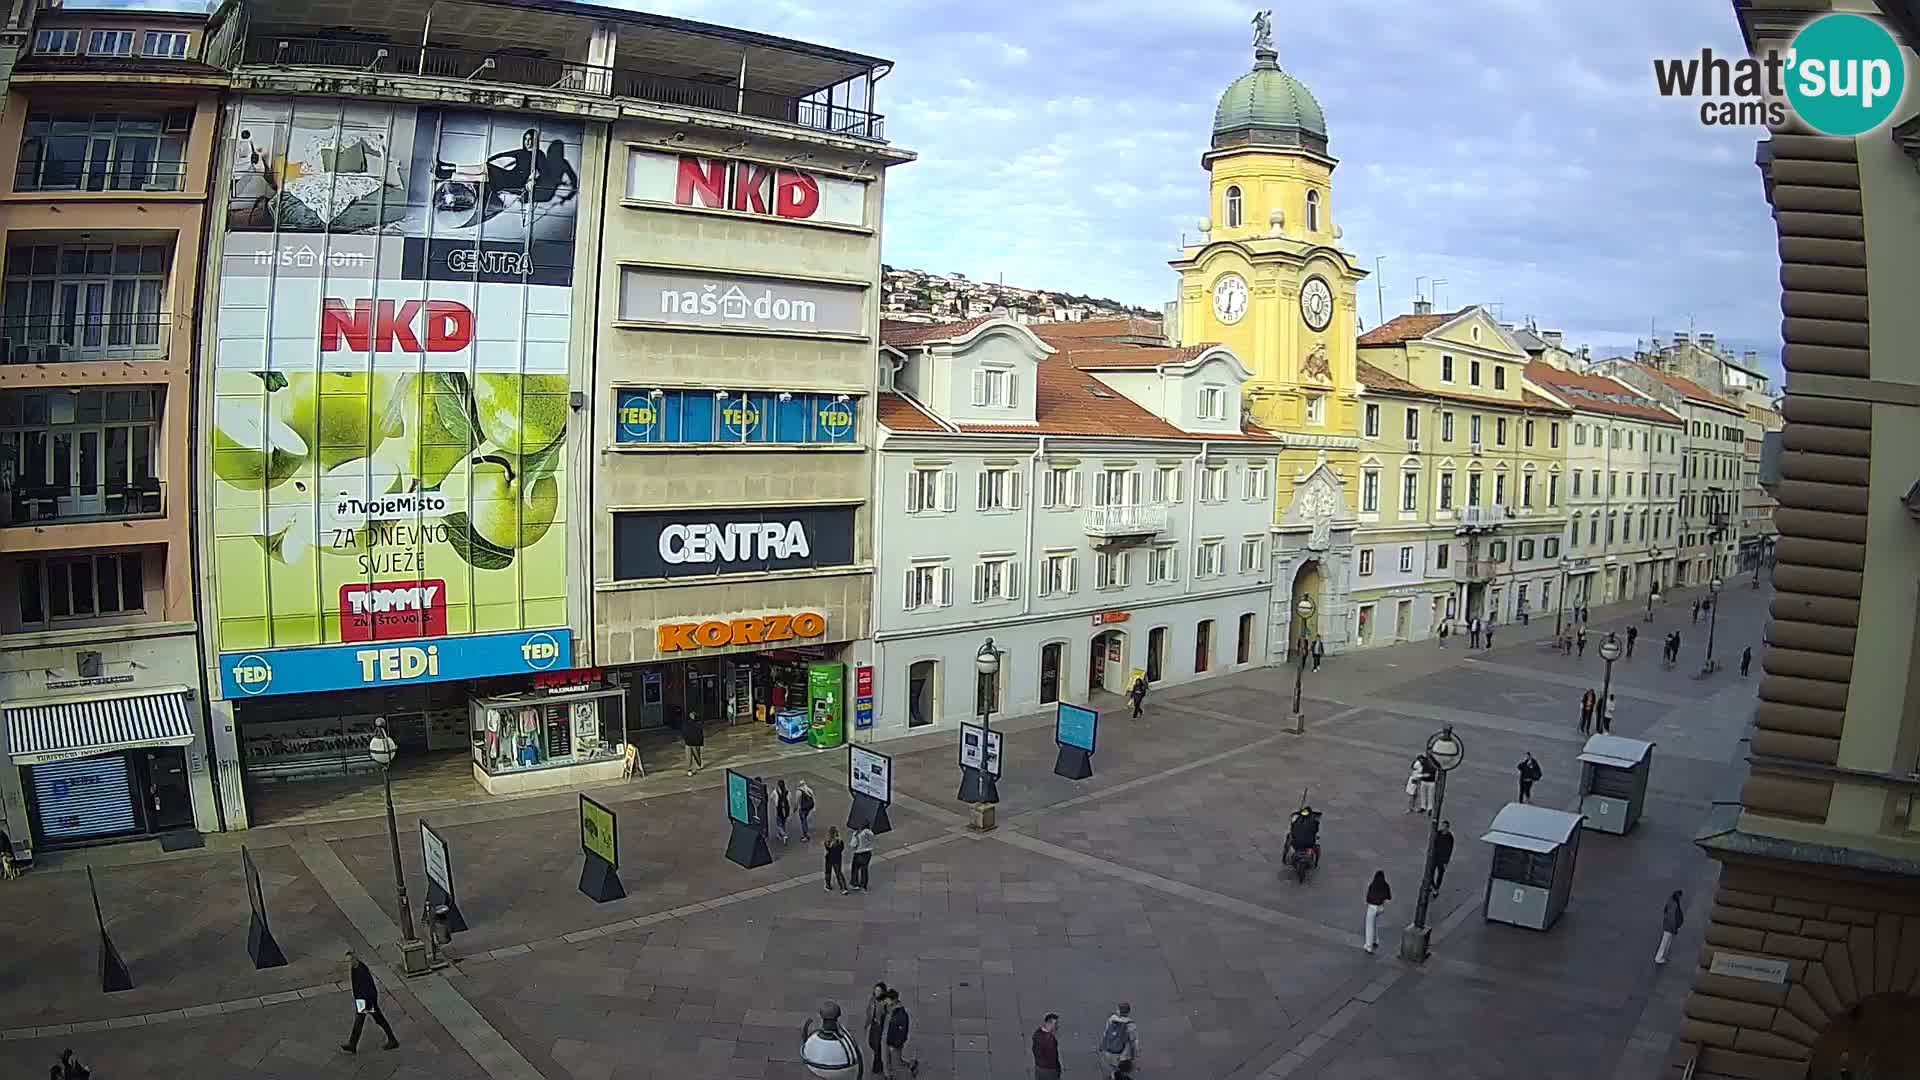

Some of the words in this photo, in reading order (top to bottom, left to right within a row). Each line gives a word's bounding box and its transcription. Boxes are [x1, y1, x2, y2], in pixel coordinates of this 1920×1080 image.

[675, 156, 820, 219] NKD
[447, 249, 535, 275] CENTRA
[660, 284, 716, 316] naš
[754, 289, 816, 322] dom
[320, 297, 477, 352] NKD
[619, 407, 657, 424] TEDi
[819, 411, 853, 426] TEDi
[337, 497, 445, 516] #TvojeMisto
[332, 528, 356, 549] ZA
[367, 523, 449, 548] DNEVNO
[659, 520, 810, 564] CENTRA
[358, 548, 425, 575] SVJEŽE
[347, 586, 438, 614] TOMMY
[658, 612, 825, 652] KORZO
[357, 645, 439, 682] TEDi
[521, 642, 559, 661] TEDi
[233, 665, 273, 682] TEDi
